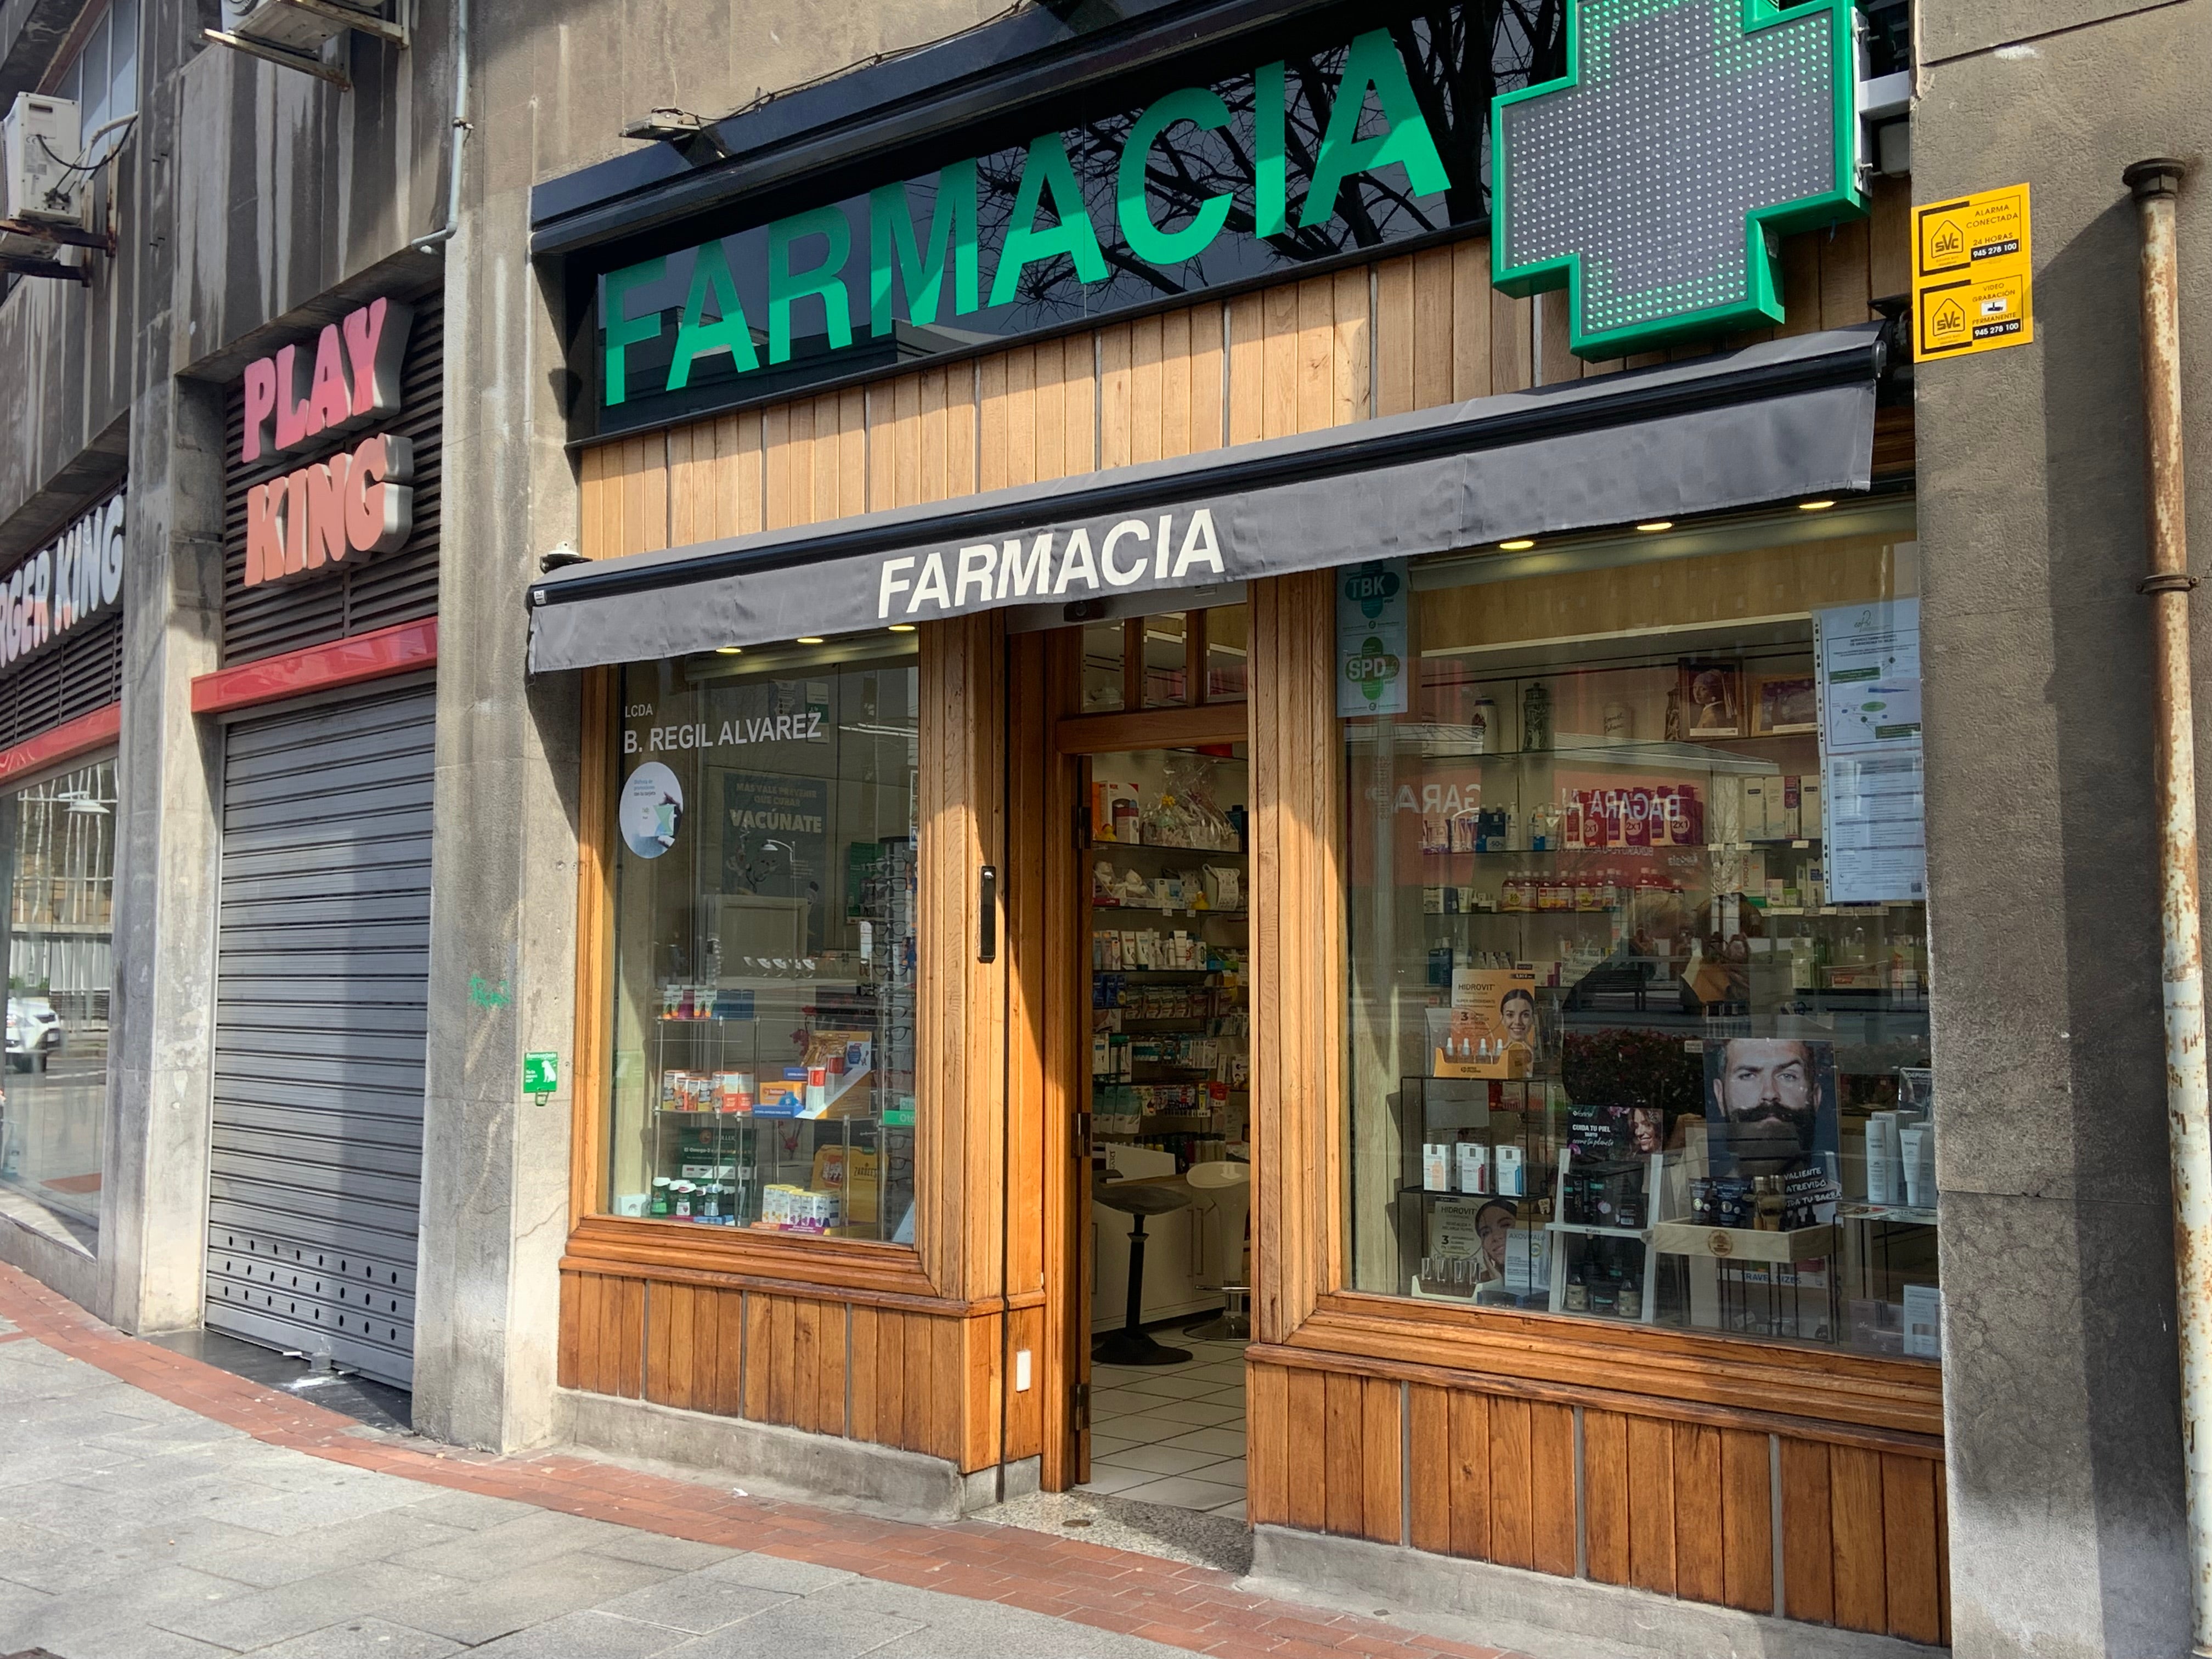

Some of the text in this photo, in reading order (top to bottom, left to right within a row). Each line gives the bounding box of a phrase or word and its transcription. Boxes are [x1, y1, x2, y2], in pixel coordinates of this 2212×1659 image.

[605, 27, 1451, 407] FARMACIA
[1975, 204, 2009, 217] ALARMA
[1966, 212, 2018, 228] CONECTADA
[1985, 233, 2013, 244] HORAS
[1972, 290, 2015, 302] GRABACIÓN
[1972, 312, 2016, 325] PERMANENTE
[242, 297, 387, 463] PLAY
[245, 432, 386, 587] KING
[54, 494, 124, 635] KING
[878, 509, 1225, 619] FARMACIA
[1350, 575, 1385, 597] TBK
[1348, 658, 1386, 680] SPD
[625, 703, 653, 718] LCDA
[624, 712, 822, 754] B. REGIL ALVAREZ
[758, 785, 777, 794] VALE
[729, 808, 822, 833] VACÚNATE
[1460, 1012, 1469, 1021] 3
[1784, 1167, 1821, 1180] VALIENTE
[1786, 1179, 1826, 1193] ATREVIDO
[1441, 1206, 1475, 1215] HIDROVIT
[1441, 1235, 1449, 1245] 3
[1509, 1233, 1541, 1241] AXOVAL
